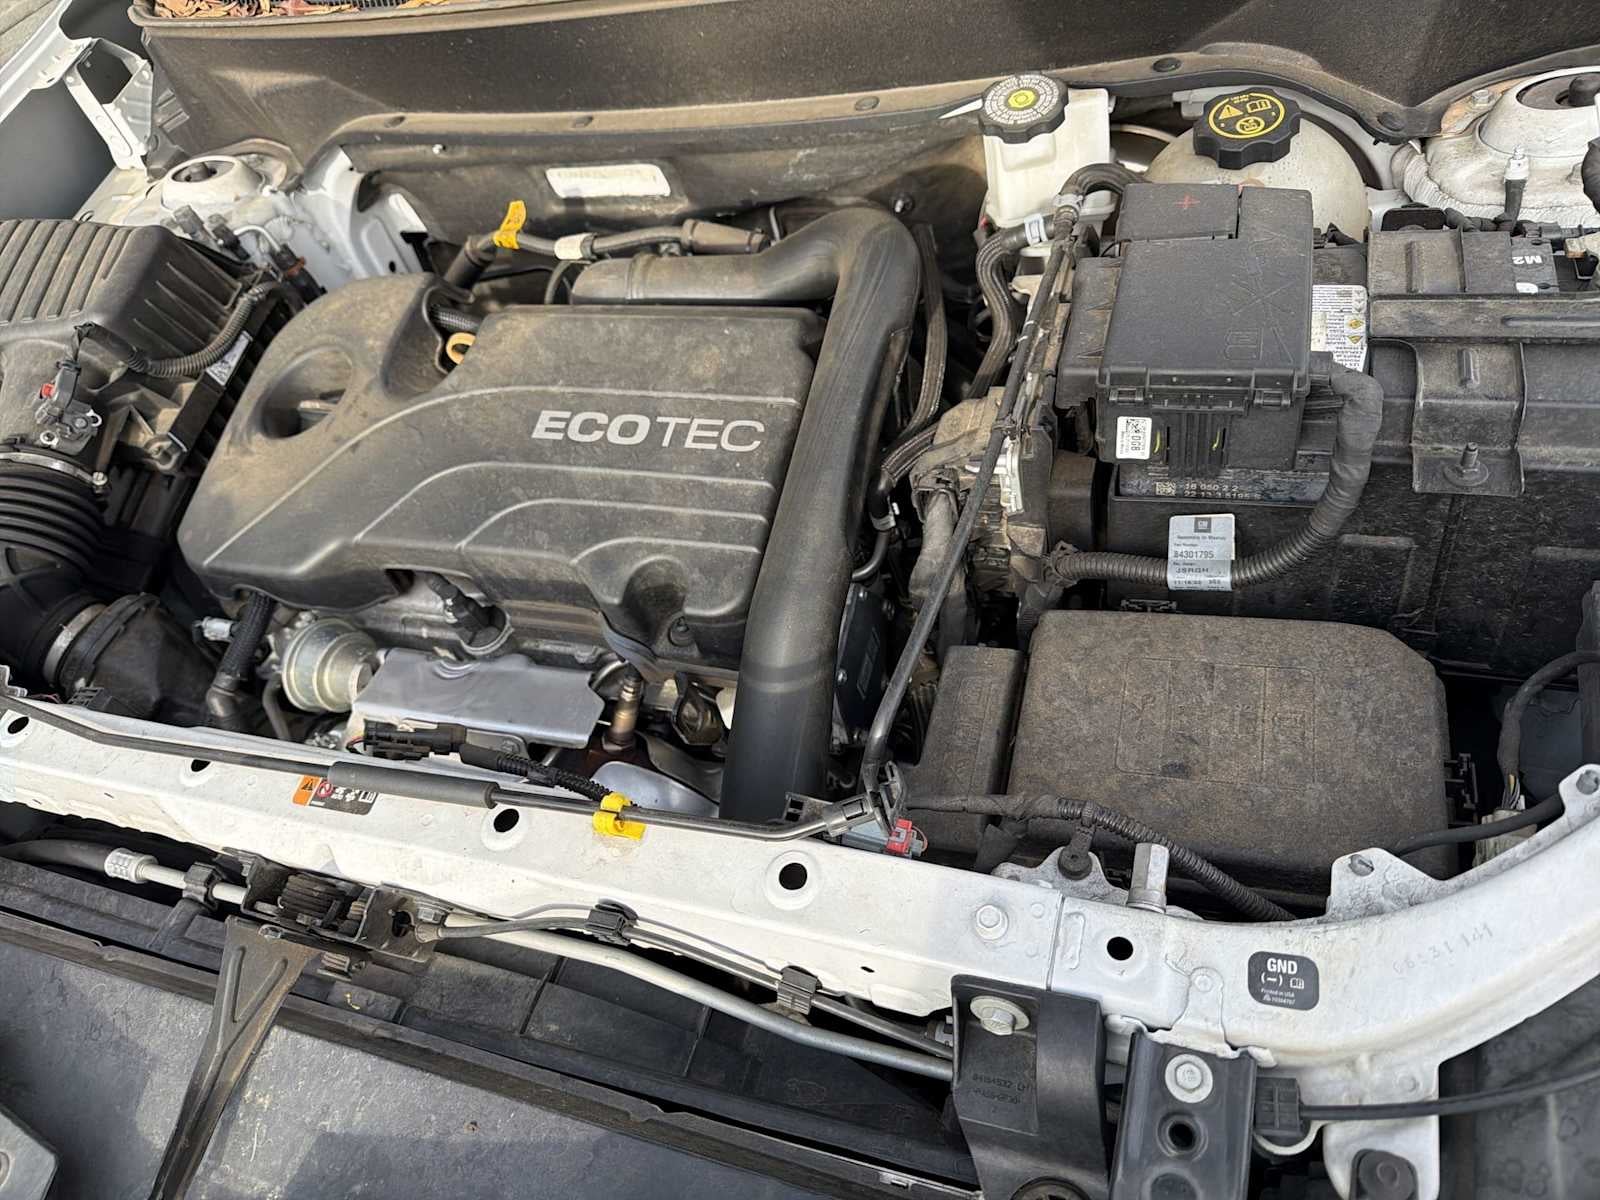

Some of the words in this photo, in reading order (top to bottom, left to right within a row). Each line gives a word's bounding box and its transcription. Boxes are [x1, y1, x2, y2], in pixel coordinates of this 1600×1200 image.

[1512, 255, 1542, 265] M2
[531, 410, 765, 453] ECOTEC
[1174, 550, 1214, 559] 84301795
[1267, 958, 1298, 975] GND
